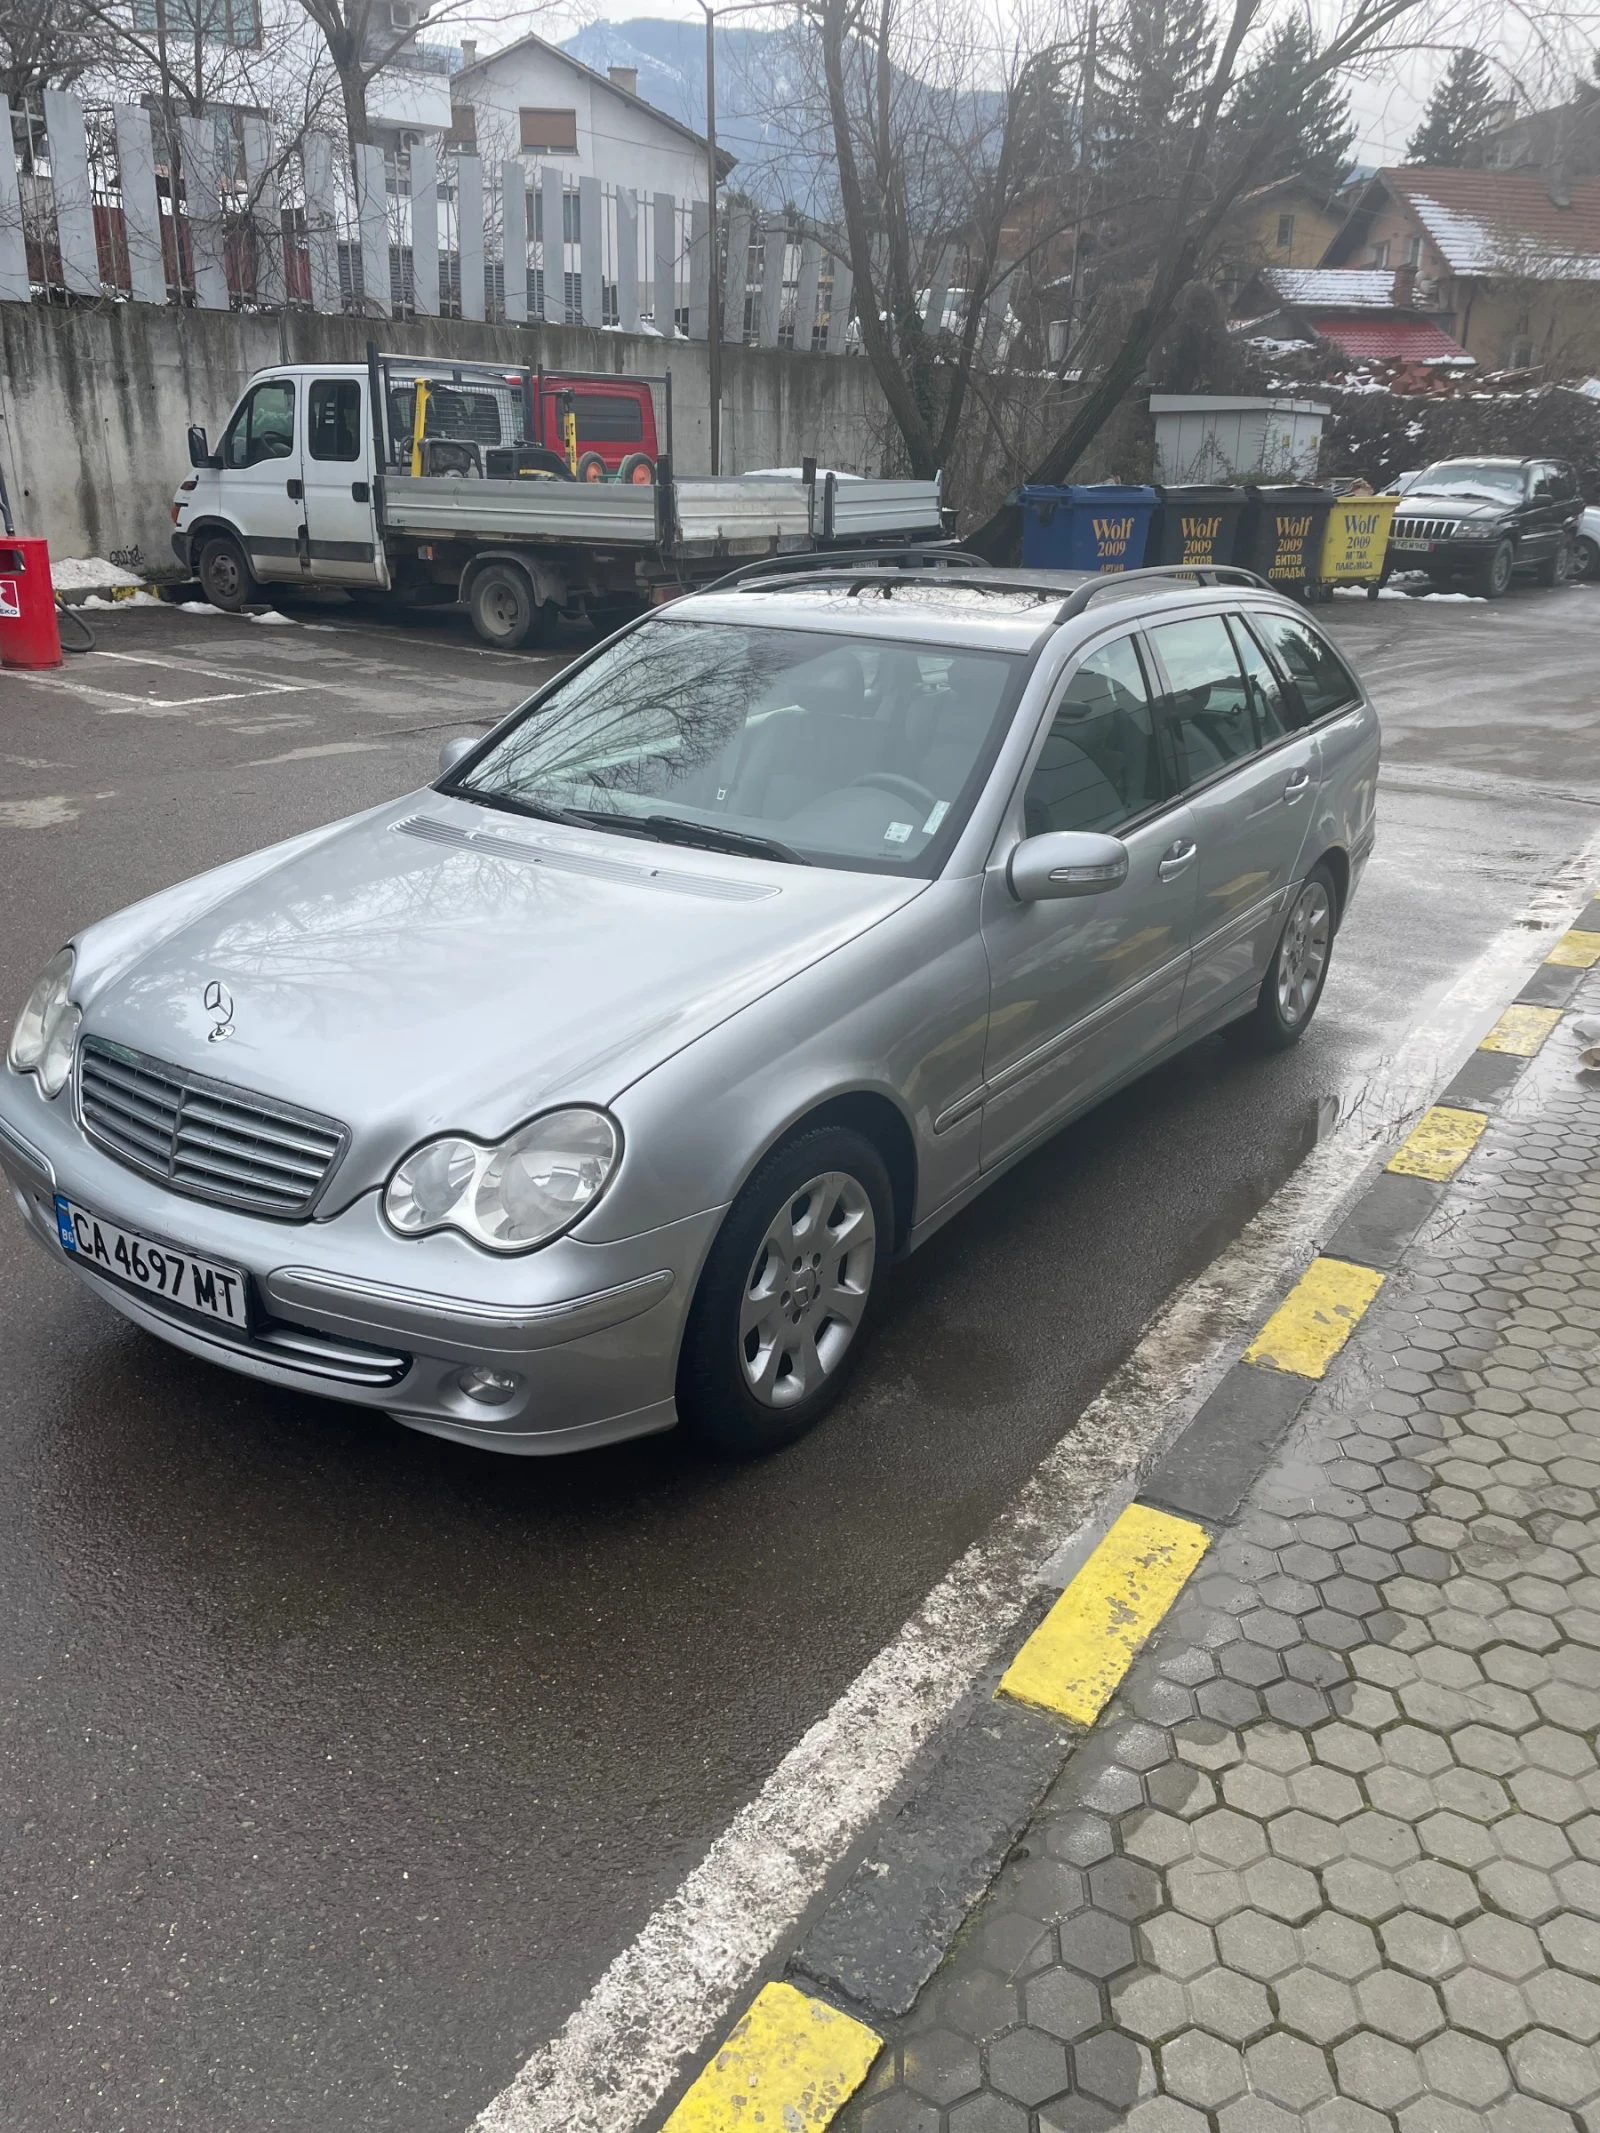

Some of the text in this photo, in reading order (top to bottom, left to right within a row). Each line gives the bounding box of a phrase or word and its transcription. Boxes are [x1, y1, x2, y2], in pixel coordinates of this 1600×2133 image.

[1092, 518, 1135, 540] Wolf
[1181, 517, 1222, 538] Wolf
[1276, 516, 1313, 537] Wolf
[1344, 514, 1380, 534] Wolf
[1097, 541, 1126, 557] 2009
[1184, 540, 1212, 554] 2009
[1277, 539, 1303, 552] 2009
[1347, 536, 1371, 549] 2009
[1275, 554, 1302, 566] БИТОВ
[1346, 551, 1367, 560] МТАЛ
[1268, 567, 1306, 579] ОТПАДЪК
[61, 1229, 74, 1243] BG
[73, 1212, 237, 1318] CA 4697 MT
